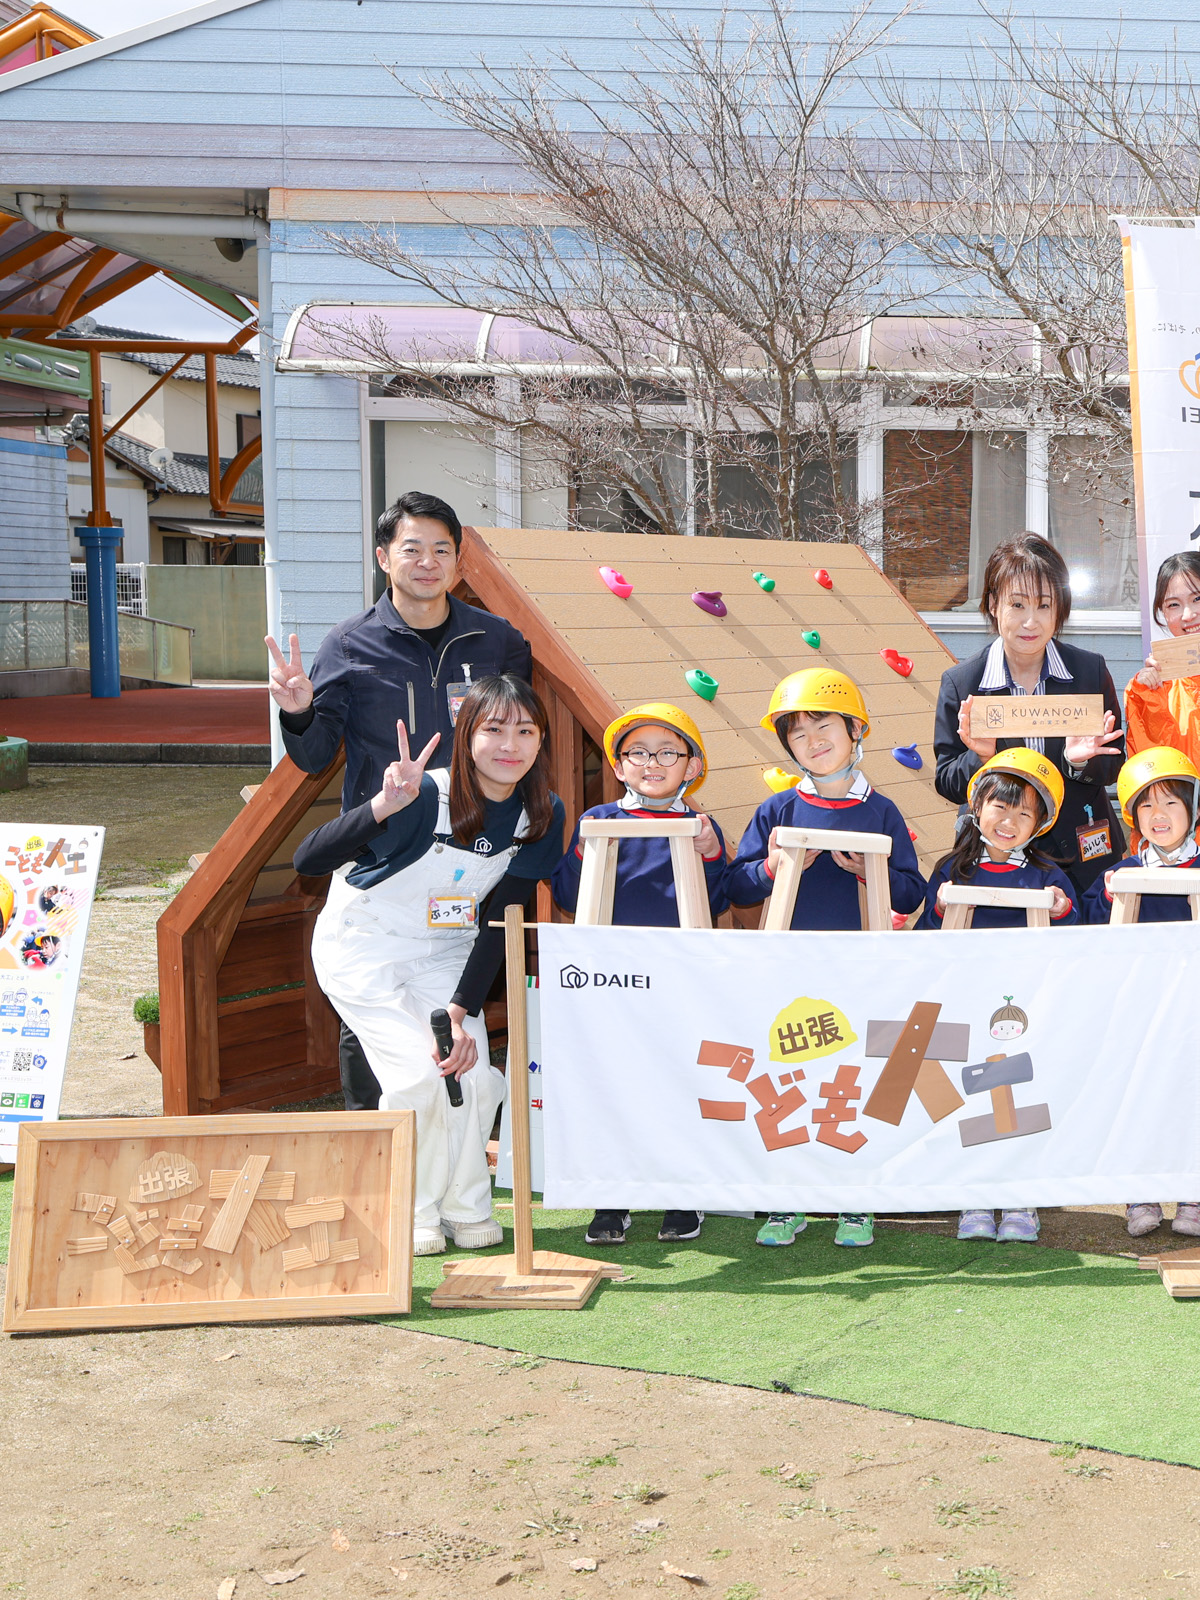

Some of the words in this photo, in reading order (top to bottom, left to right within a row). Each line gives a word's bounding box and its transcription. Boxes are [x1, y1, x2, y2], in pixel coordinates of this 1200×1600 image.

[1011, 707, 1088, 718] KUWANOMI
[592, 971, 652, 991] DAIEI
[777, 1012, 845, 1056] 出張
[696, 1000, 1053, 1155] こども大工
[138, 1165, 194, 1196] 出張
[66, 1154, 361, 1276] こども大工
